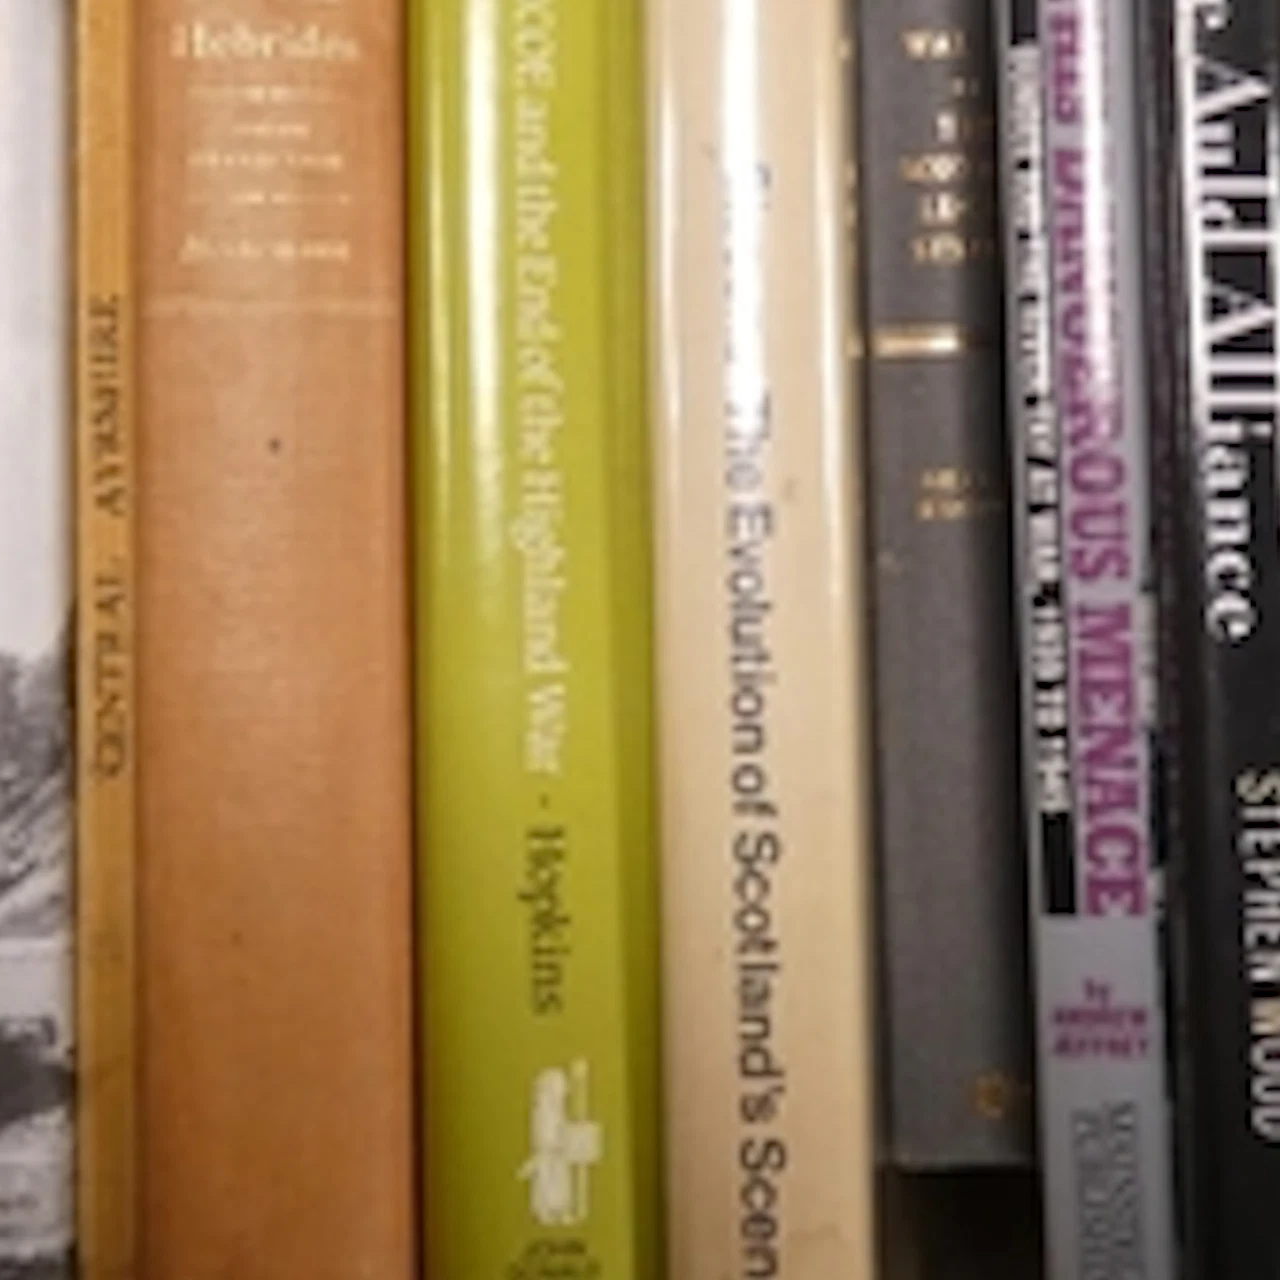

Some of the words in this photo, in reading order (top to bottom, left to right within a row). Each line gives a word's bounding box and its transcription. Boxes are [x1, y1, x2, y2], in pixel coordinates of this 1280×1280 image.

[512, 98, 559, 176] and
[1186, 55, 1280, 246] Auld
[514, 182, 560, 253] the
[516, 256, 562, 342] End
[516, 347, 565, 394] of
[519, 396, 564, 465] the
[509, 469, 569, 672] Highland
[723, 503, 775, 758] Evolution
[523, 682, 568, 775] War
[1076, 605, 1148, 917] MENACE
[728, 764, 779, 818] of
[516, 825, 572, 1016] Hopkins
[731, 830, 786, 1122] Scotland's
